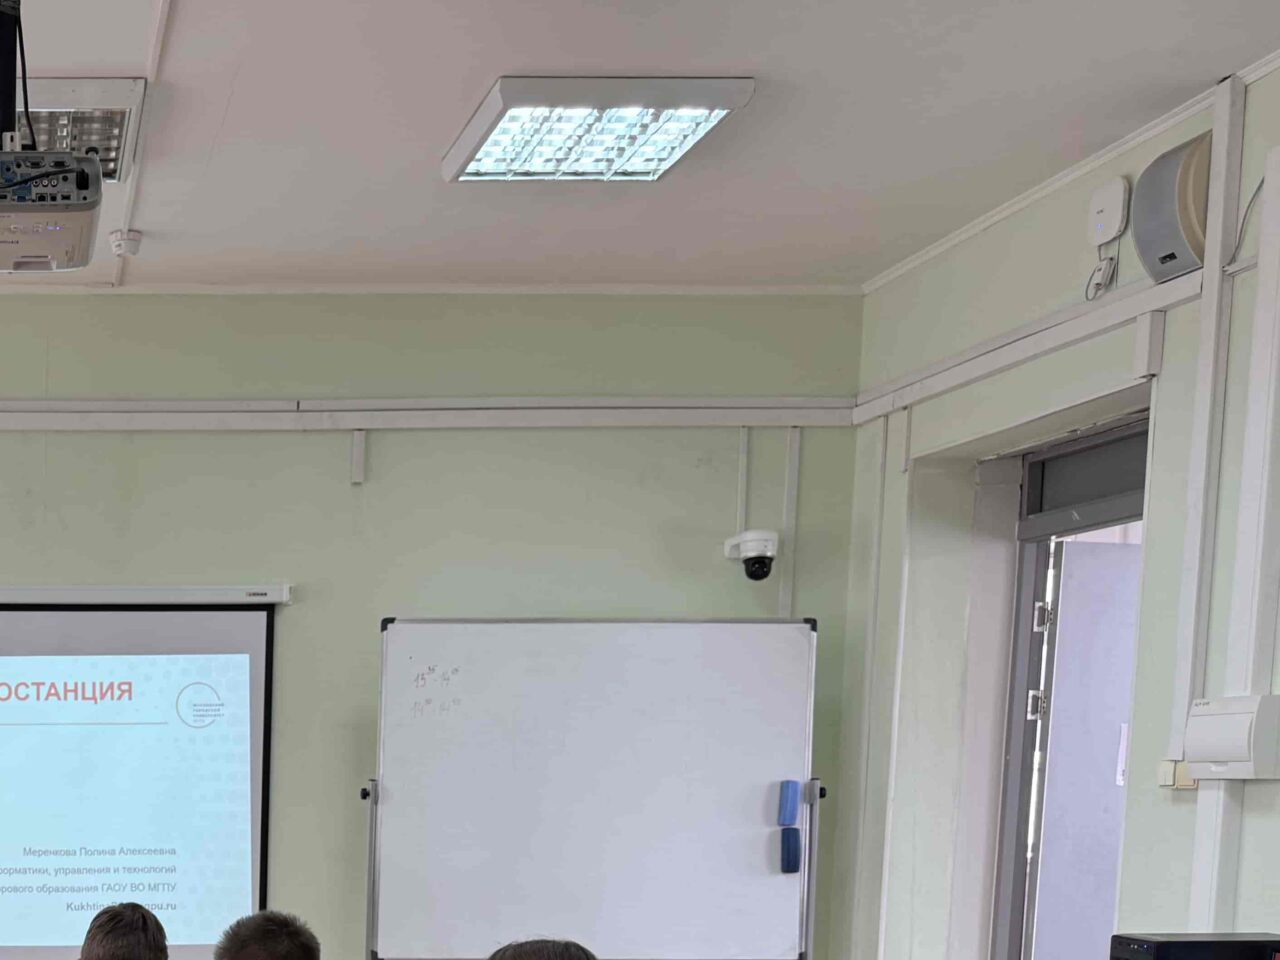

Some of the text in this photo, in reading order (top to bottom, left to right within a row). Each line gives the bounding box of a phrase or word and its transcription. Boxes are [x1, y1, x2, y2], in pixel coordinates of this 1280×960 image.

[23, 846, 177, 858] Меренкова Полина Алексеевна
[54, 867, 111, 877] управления
[122, 865, 177, 875] технологий
[36, 884, 99, 895] образования
[101, 883, 127, 893] ГАОУ
[130, 883, 146, 893] ВО
[148, 882, 177, 893] МГПУ
